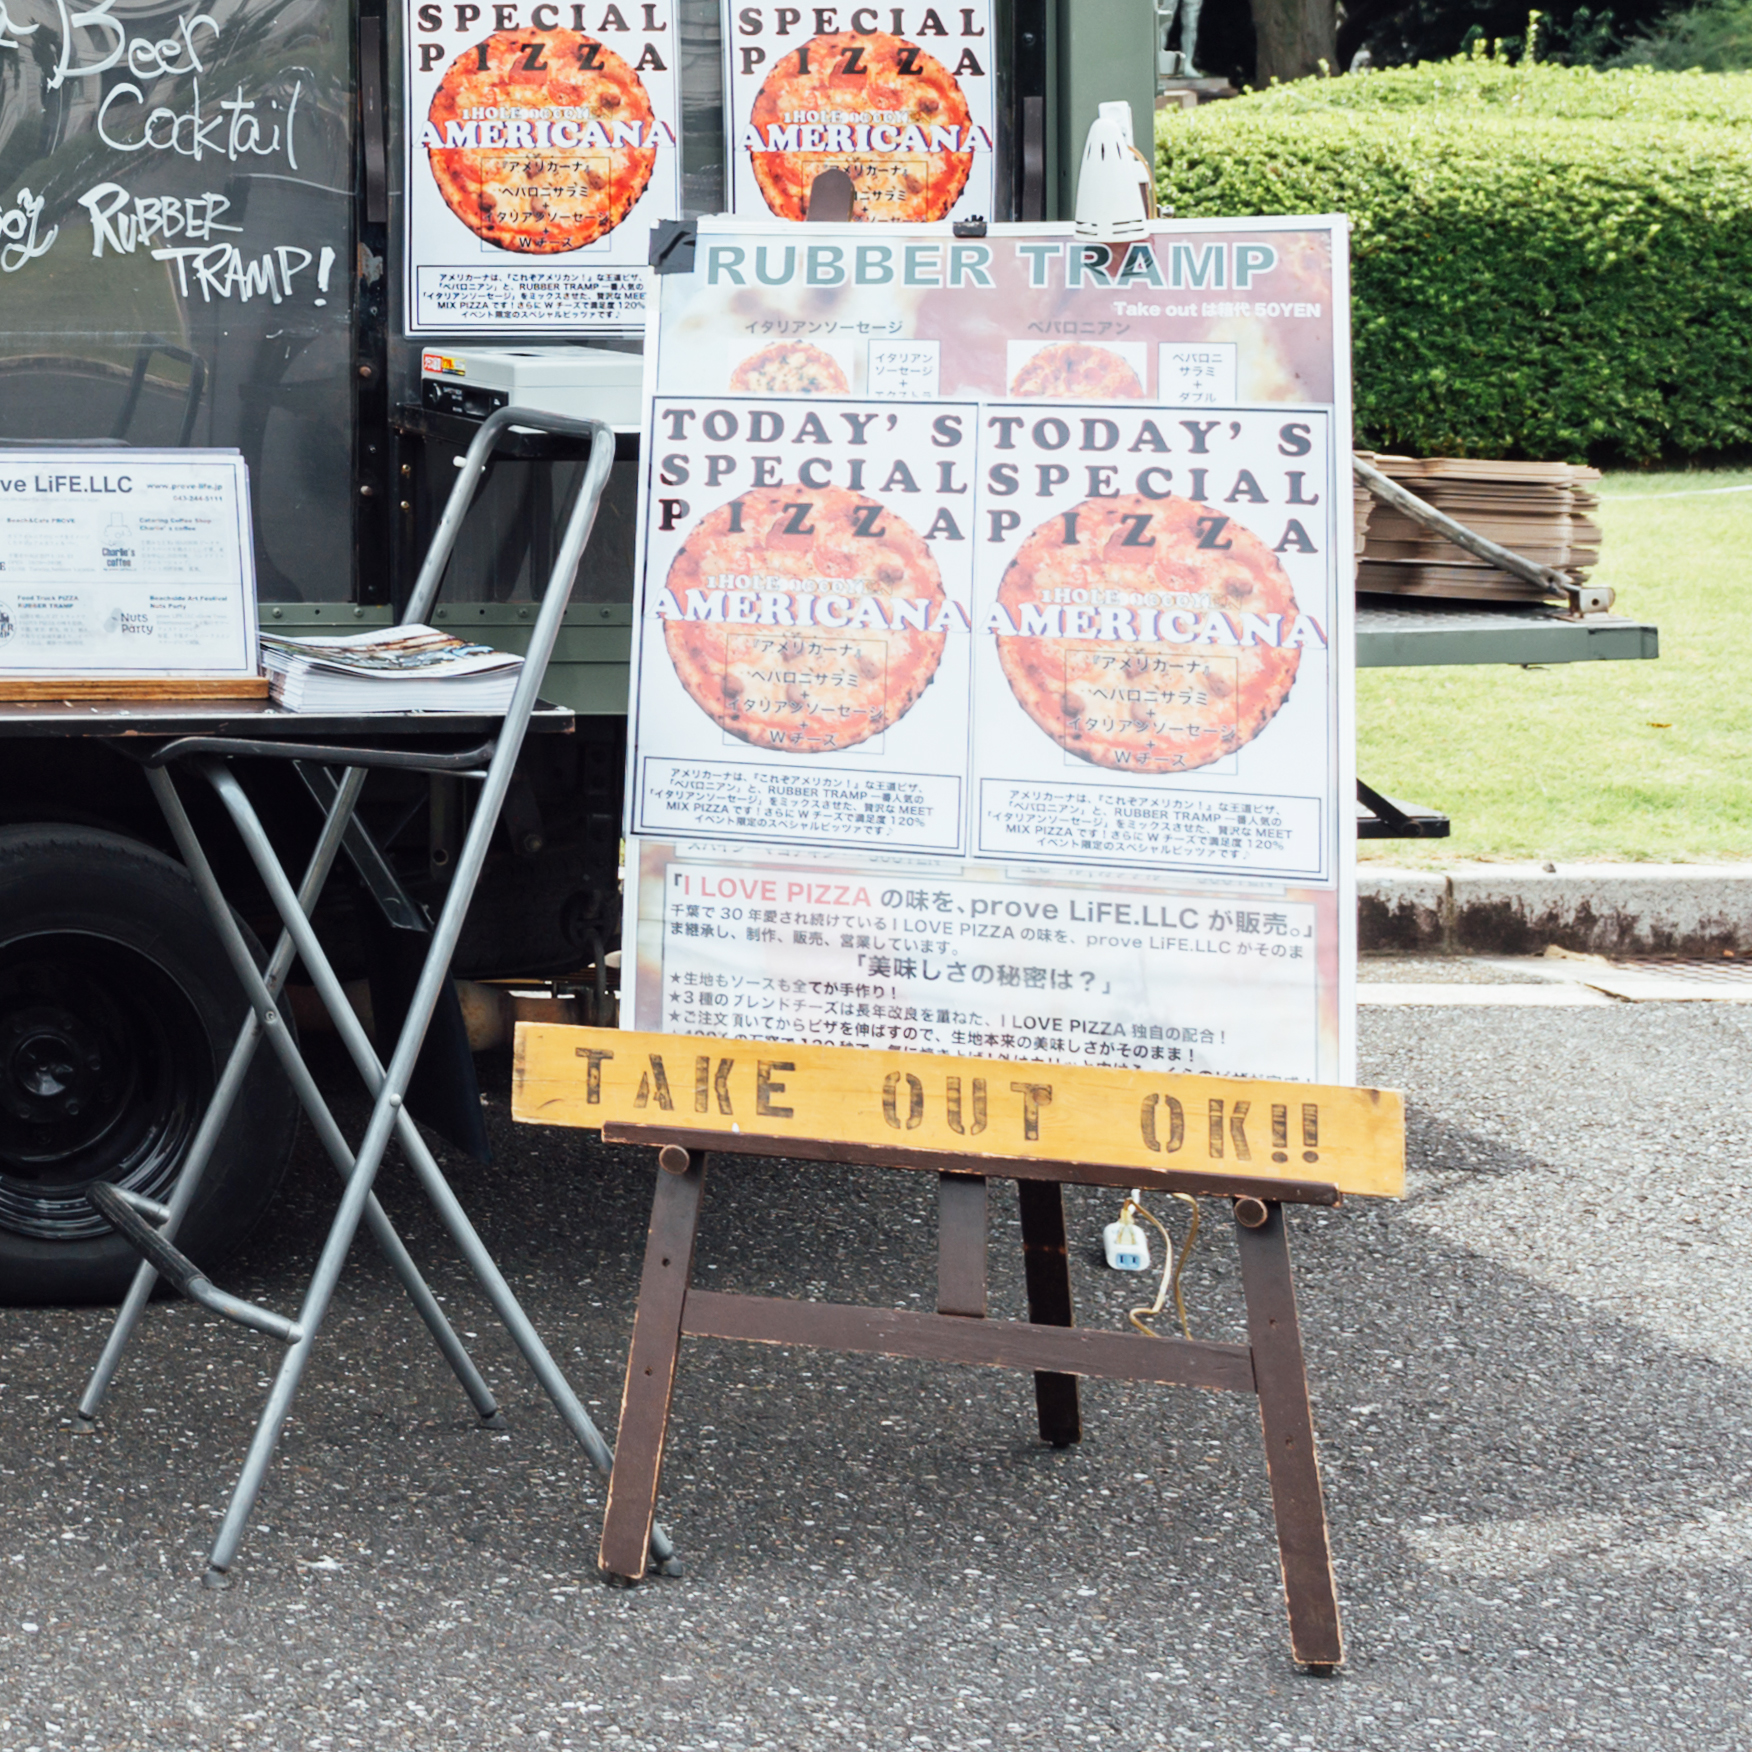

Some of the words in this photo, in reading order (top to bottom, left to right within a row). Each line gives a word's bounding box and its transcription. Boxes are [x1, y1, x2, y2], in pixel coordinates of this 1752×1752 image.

[418, 3, 667, 32] SPECIAL
[738, 7, 985, 37] SPECIAL
[418, 43, 667, 72] PIZZA
[739, 46, 985, 77] PIZZA
[413, 120, 676, 148] AMERICANA
[735, 123, 993, 153] AMERICANA
[705, 243, 996, 289] RUBBER
[1016, 242, 1279, 290] TRAMP
[1113, 301, 1161, 317] Take
[1165, 304, 1198, 317] out
[1254, 303, 1321, 318] 50YEN
[745, 320, 902, 335] イタリアンソーセージ
[875, 353, 933, 364] イタリアン
[875, 365, 934, 377] ソーセージ
[1179, 366, 1216, 377] サラミ
[660, 454, 967, 494] SPECIAL
[988, 463, 1319, 506] SPECIAL
[658, 499, 965, 540] PIZZA
[986, 509, 1319, 554] PIZZA
[121, 613, 149, 622] Nuts
[646, 587, 971, 633] AMERICANA
[122, 624, 154, 635] Party
[978, 601, 1328, 650] AMERICANA
[768, 785, 818, 798] RUBBER
[823, 788, 868, 800] TRAMP
[666, 801, 689, 811] MIX
[694, 802, 729, 814] PIZZA
[891, 815, 926, 827] 120%
[899, 805, 934, 817] MEET
[1114, 807, 1169, 820] RUBBER
[1174, 810, 1222, 823] TRAMP
[1006, 824, 1031, 834] MIX
[1035, 825, 1073, 837] PIZZA
[1247, 839, 1284, 851] 120%
[1256, 828, 1293, 839] MEET
[700, 876, 777, 902] LOVE
[787, 882, 871, 907] PIZZA
[720, 907, 743, 920] 30
[903, 921, 954, 935] LOVE
[960, 922, 1015, 940] PIZZA
[1086, 933, 1143, 949] prove
[1013, 1015, 1063, 1032] LOVE
[1070, 1018, 1127, 1038] PIZZA
[574, 1046, 797, 1119] TAKE
[881, 1070, 1054, 1142] OUT
[1140, 1091, 1321, 1165] OK!!
